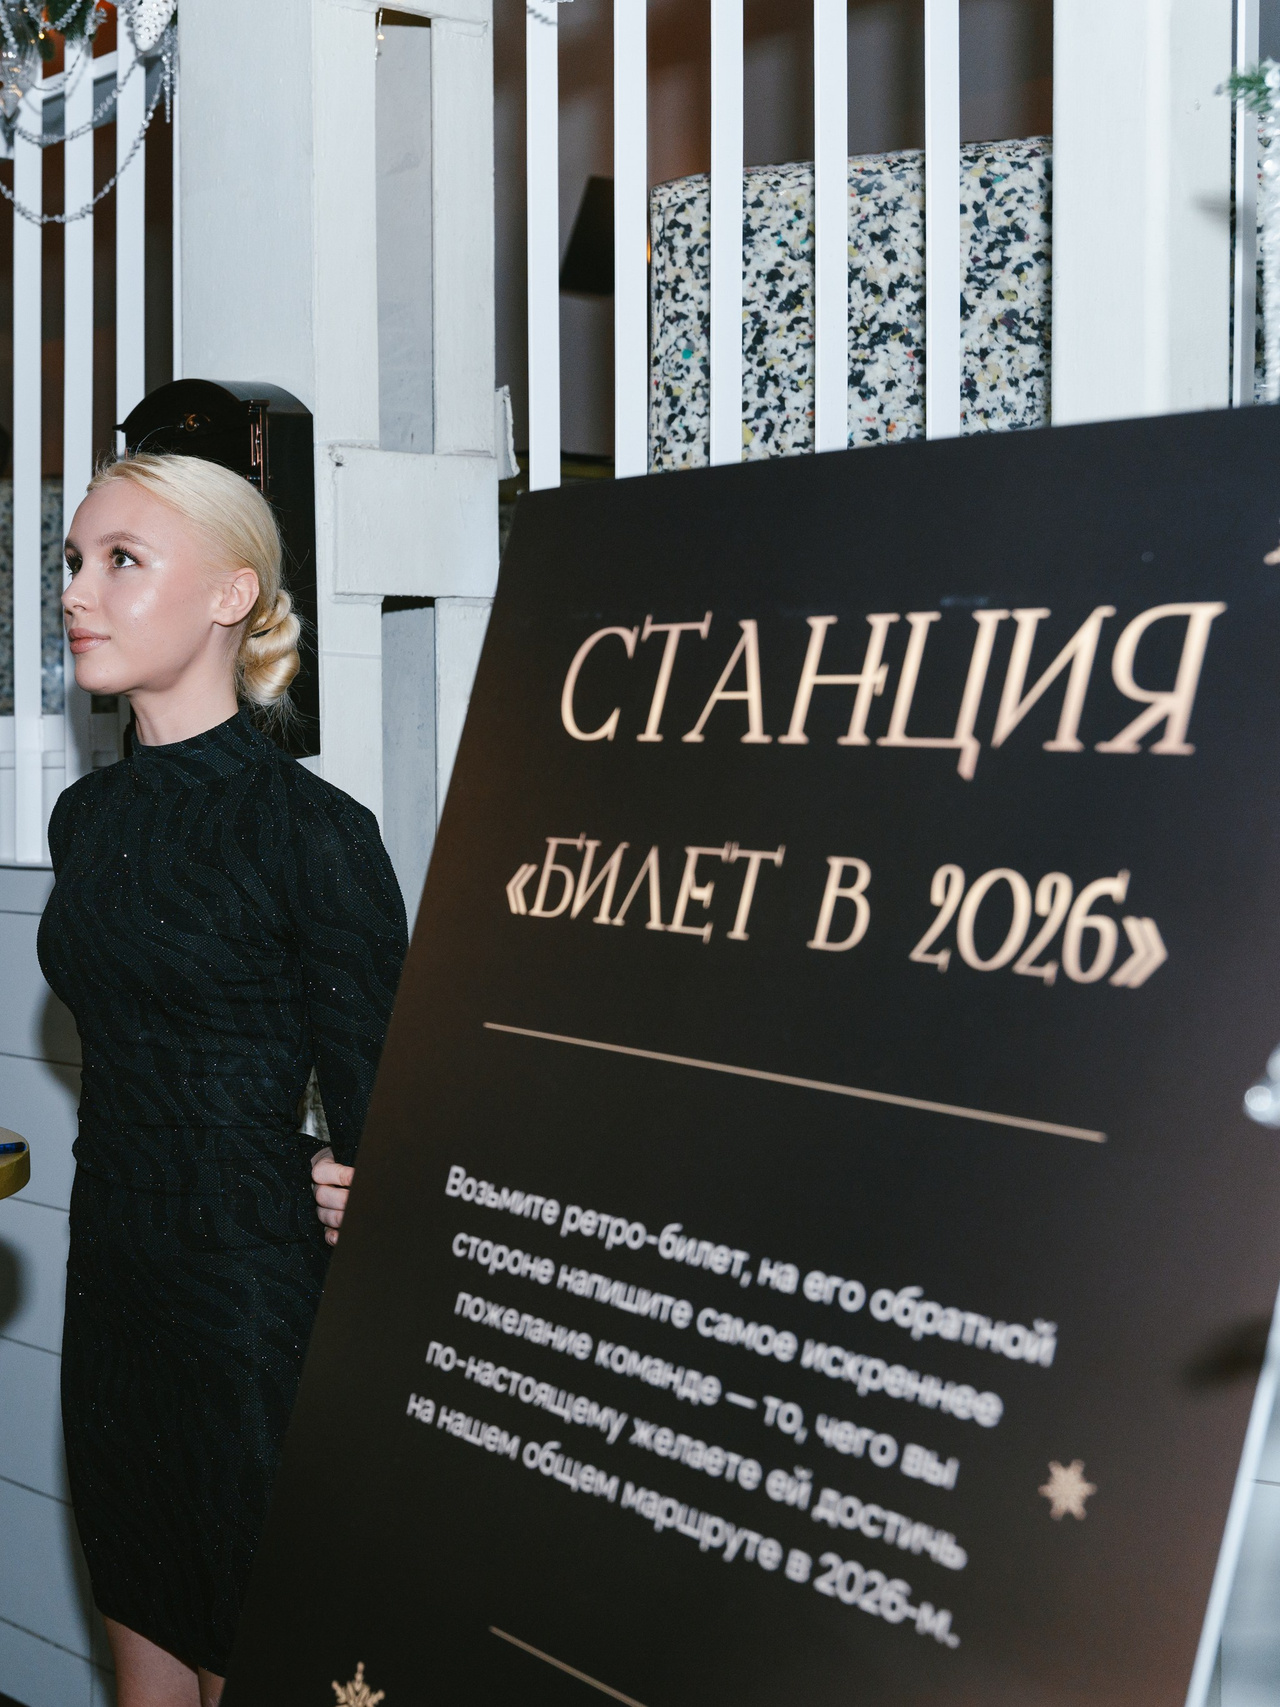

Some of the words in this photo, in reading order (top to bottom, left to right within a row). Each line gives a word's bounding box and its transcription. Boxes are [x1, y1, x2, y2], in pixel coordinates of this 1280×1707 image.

[561, 601, 1227, 780] СТАНЦИЯ
[506, 834, 785, 942] «БИЛЕТ
[807, 856, 871, 951] В
[909, 864, 1168, 988] 2026»
[445, 1165, 560, 1225] Возьмите
[560, 1205, 751, 1287] ретро-билет,
[757, 1258, 799, 1294] на
[803, 1271, 866, 1312] его
[870, 1286, 1057, 1367] обратной
[452, 1233, 555, 1284] стороне
[557, 1265, 693, 1328] напишите
[697, 1308, 798, 1362] самое
[801, 1339, 1003, 1427] искреннее
[426, 1341, 628, 1444] по-настоящему
[630, 1418, 762, 1490] желаете
[766, 1467, 812, 1509] ей
[811, 1488, 967, 1570] достичь
[455, 1292, 593, 1360] пожелание
[595, 1341, 721, 1405] команде
[763, 1396, 807, 1443] то,
[816, 1415, 898, 1467] чего
[900, 1444, 959, 1489] вы
[407, 1394, 435, 1423] на
[437, 1406, 520, 1459] нашем
[523, 1441, 619, 1501] общем
[621, 1482, 782, 1570] маршруте
[785, 1549, 812, 1582] в
[814, 1552, 960, 1648] 2026-м.
